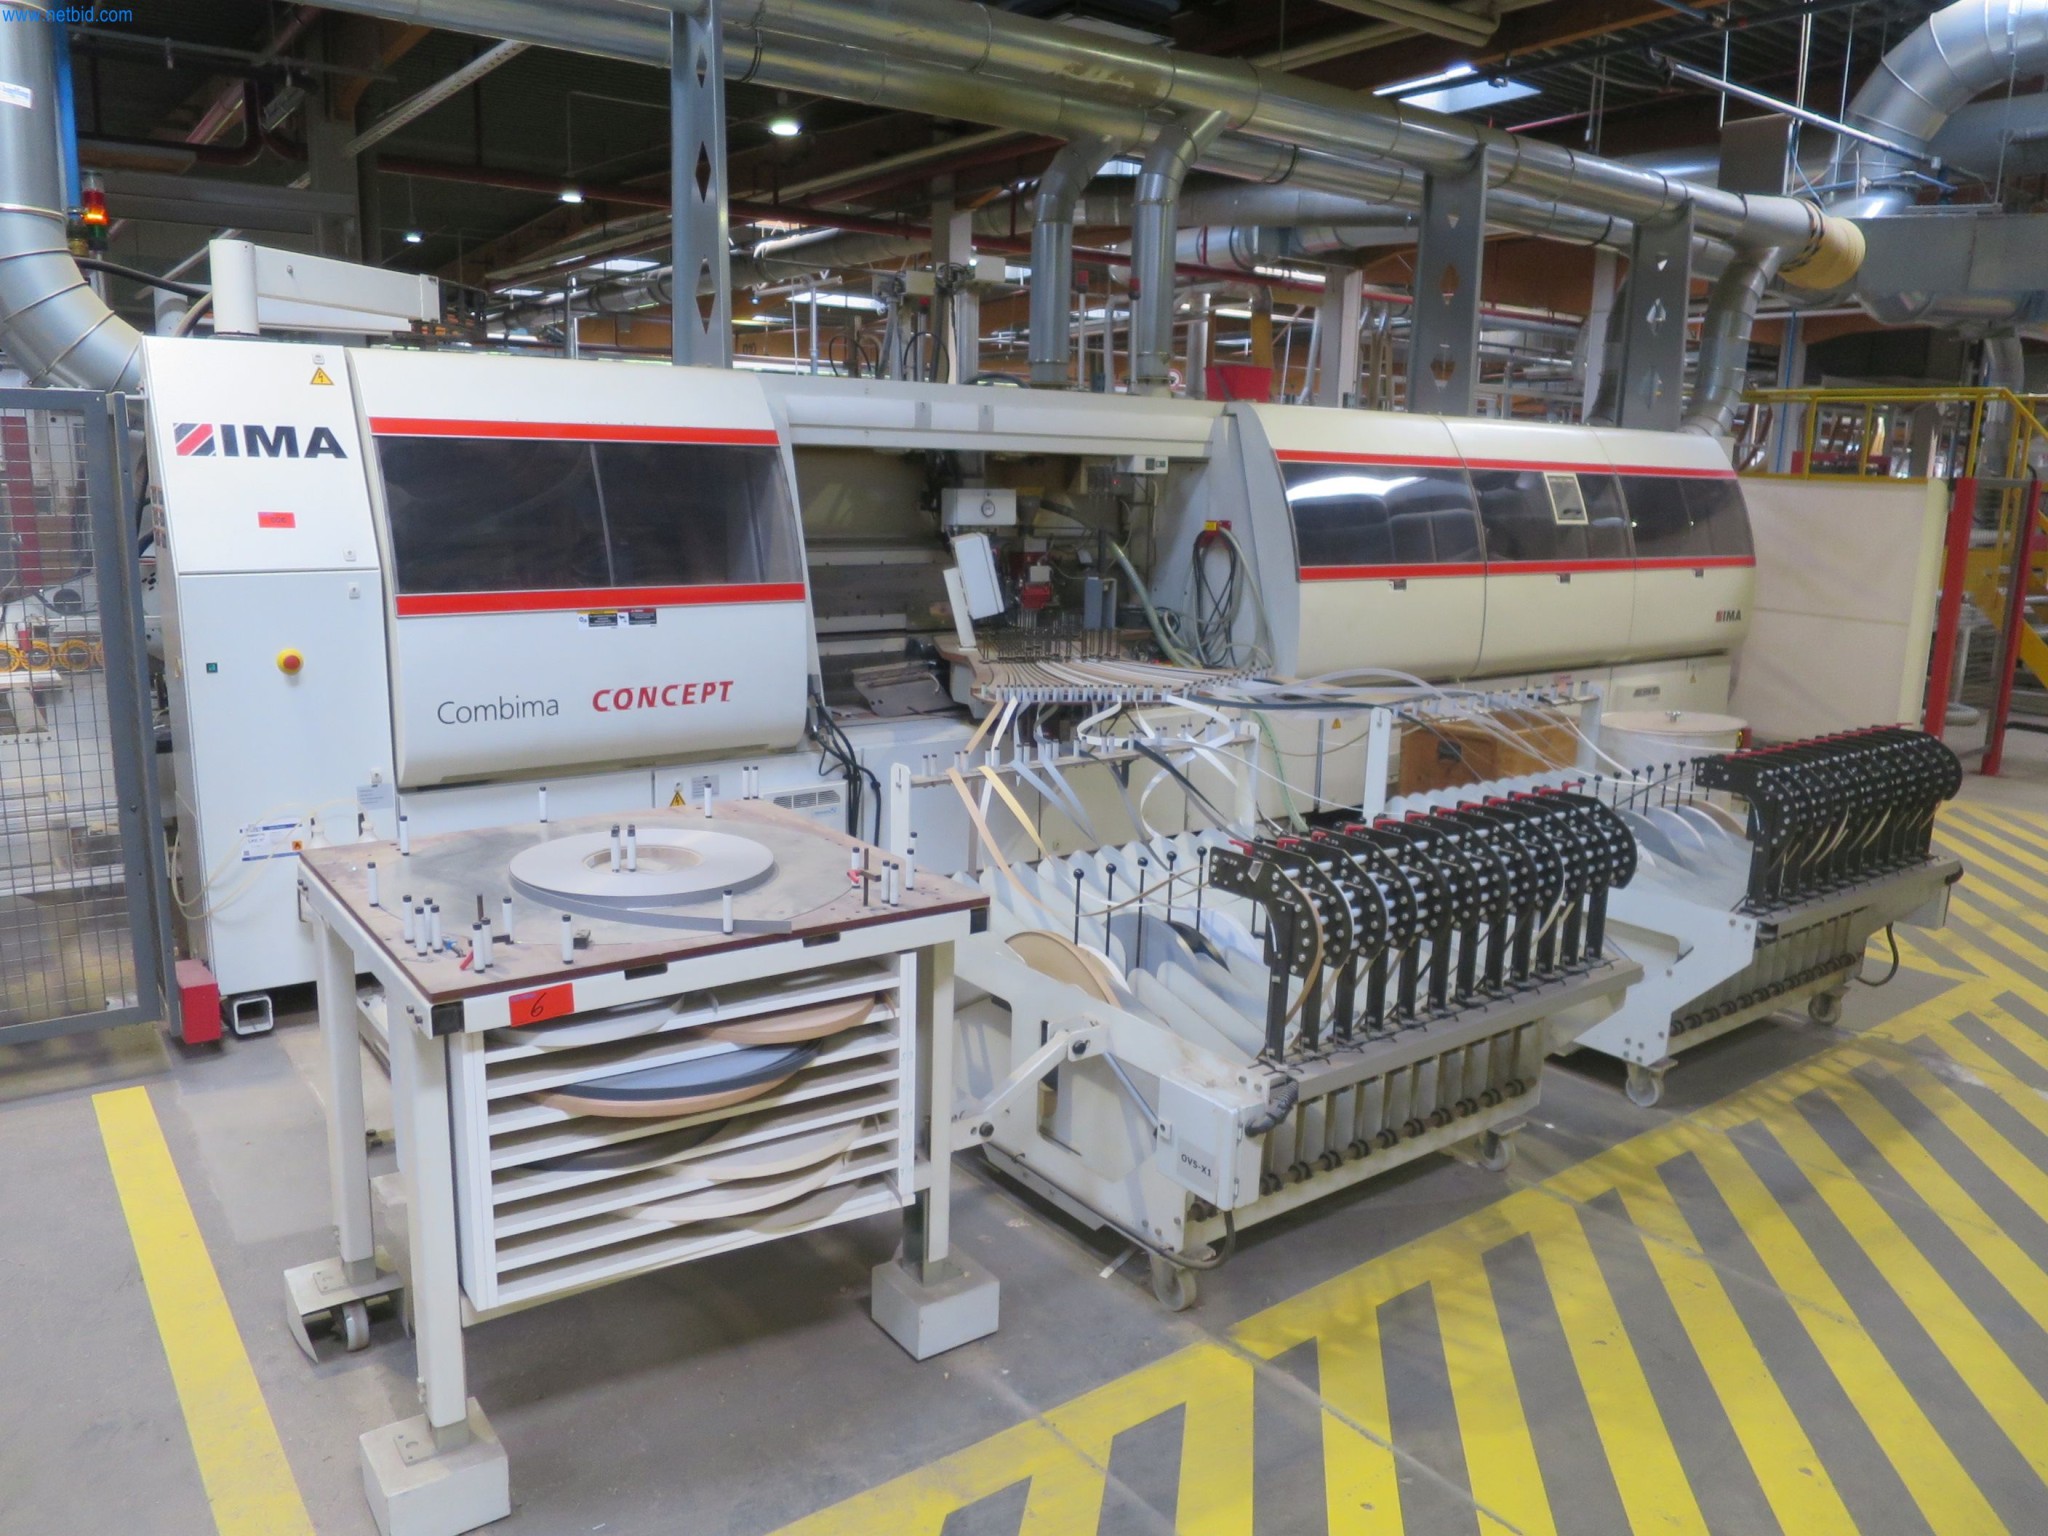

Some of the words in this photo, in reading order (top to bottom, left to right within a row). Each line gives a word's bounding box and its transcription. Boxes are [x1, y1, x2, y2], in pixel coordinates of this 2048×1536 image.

[220, 424, 348, 459] IMA
[1723, 609, 1742, 622] IMA
[437, 695, 559, 724] Combima
[592, 680, 734, 712] CONCEPT
[530, 992, 546, 1018] 6
